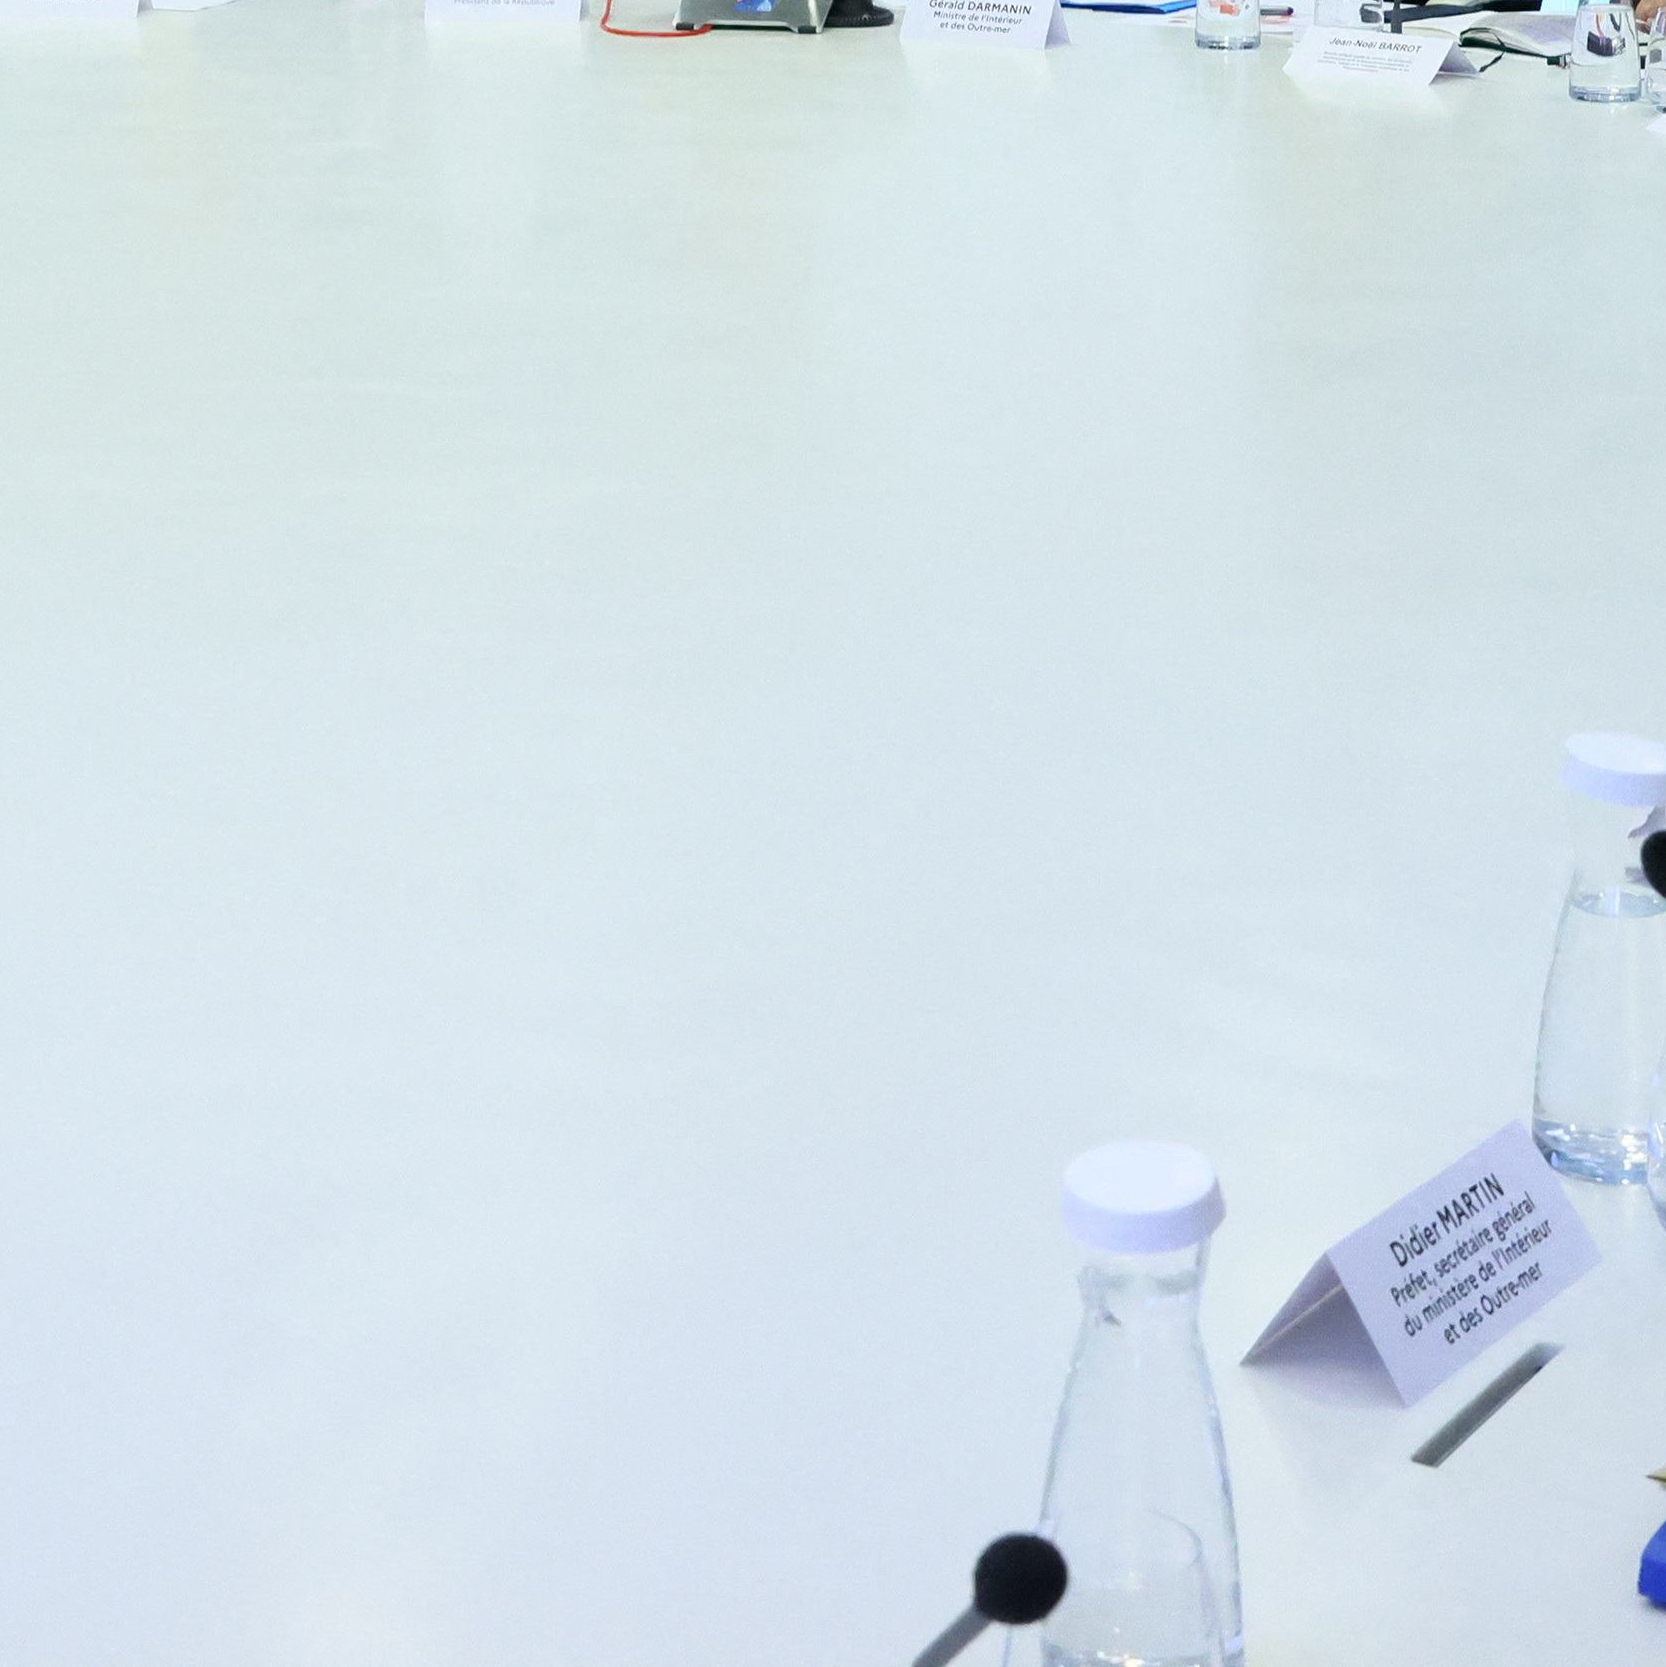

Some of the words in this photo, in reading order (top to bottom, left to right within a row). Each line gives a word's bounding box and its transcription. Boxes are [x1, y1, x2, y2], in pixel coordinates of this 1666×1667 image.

[933, 10, 966, 21] Ministre
[968, 13, 979, 21] de
[939, 21, 949, 29] et
[950, 21, 965, 30] des
[967, 23, 1011, 33] Outre-mer
[967, 1, 1032, 15] DARMANIN
[1329, 37, 1377, 49] Jean-Noël
[1378, 42, 1423, 53] BARROT
[1390, 1221, 1442, 1267] Didier
[1436, 1173, 1504, 1234] MARTIN
[1390, 1270, 1438, 1307] Préfet,
[1434, 1227, 1493, 1278] secrétaire
[1492, 1191, 1536, 1242] général
[1404, 1313, 1423, 1336] du
[1422, 1273, 1479, 1323] ministère
[1478, 1260, 1497, 1282] de
[1444, 1323, 1460, 1345] et
[1459, 1307, 1483, 1333] des
[1480, 1262, 1543, 1315] Outre-mer
